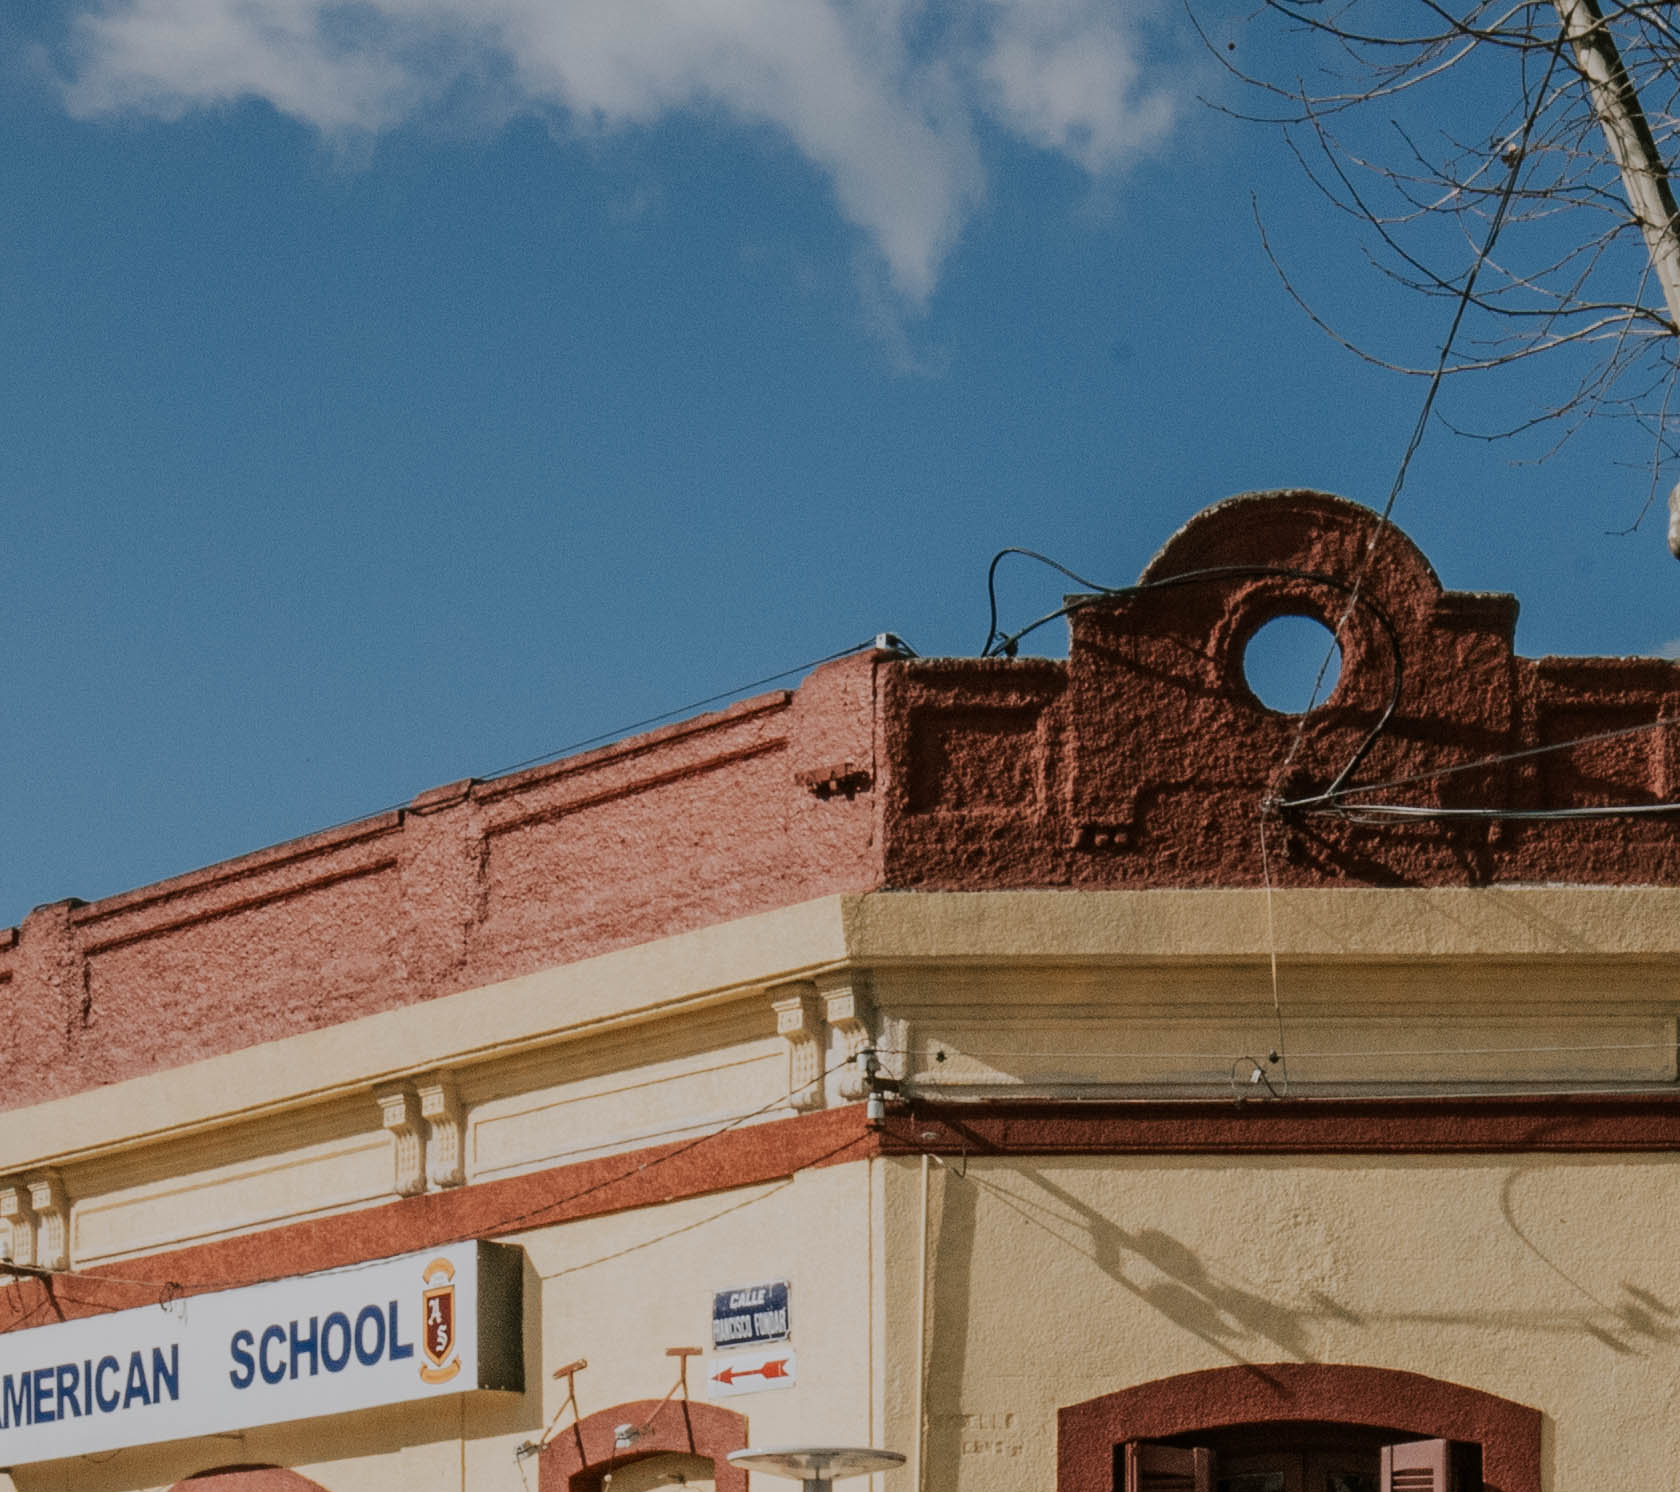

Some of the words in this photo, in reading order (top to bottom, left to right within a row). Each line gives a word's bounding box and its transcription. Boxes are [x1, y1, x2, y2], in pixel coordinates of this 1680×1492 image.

[428, 1298, 442, 1326] A
[729, 1288, 766, 1310] CALLE
[229, 1299, 415, 1390] SCHOOL
[435, 1324, 448, 1352] S
